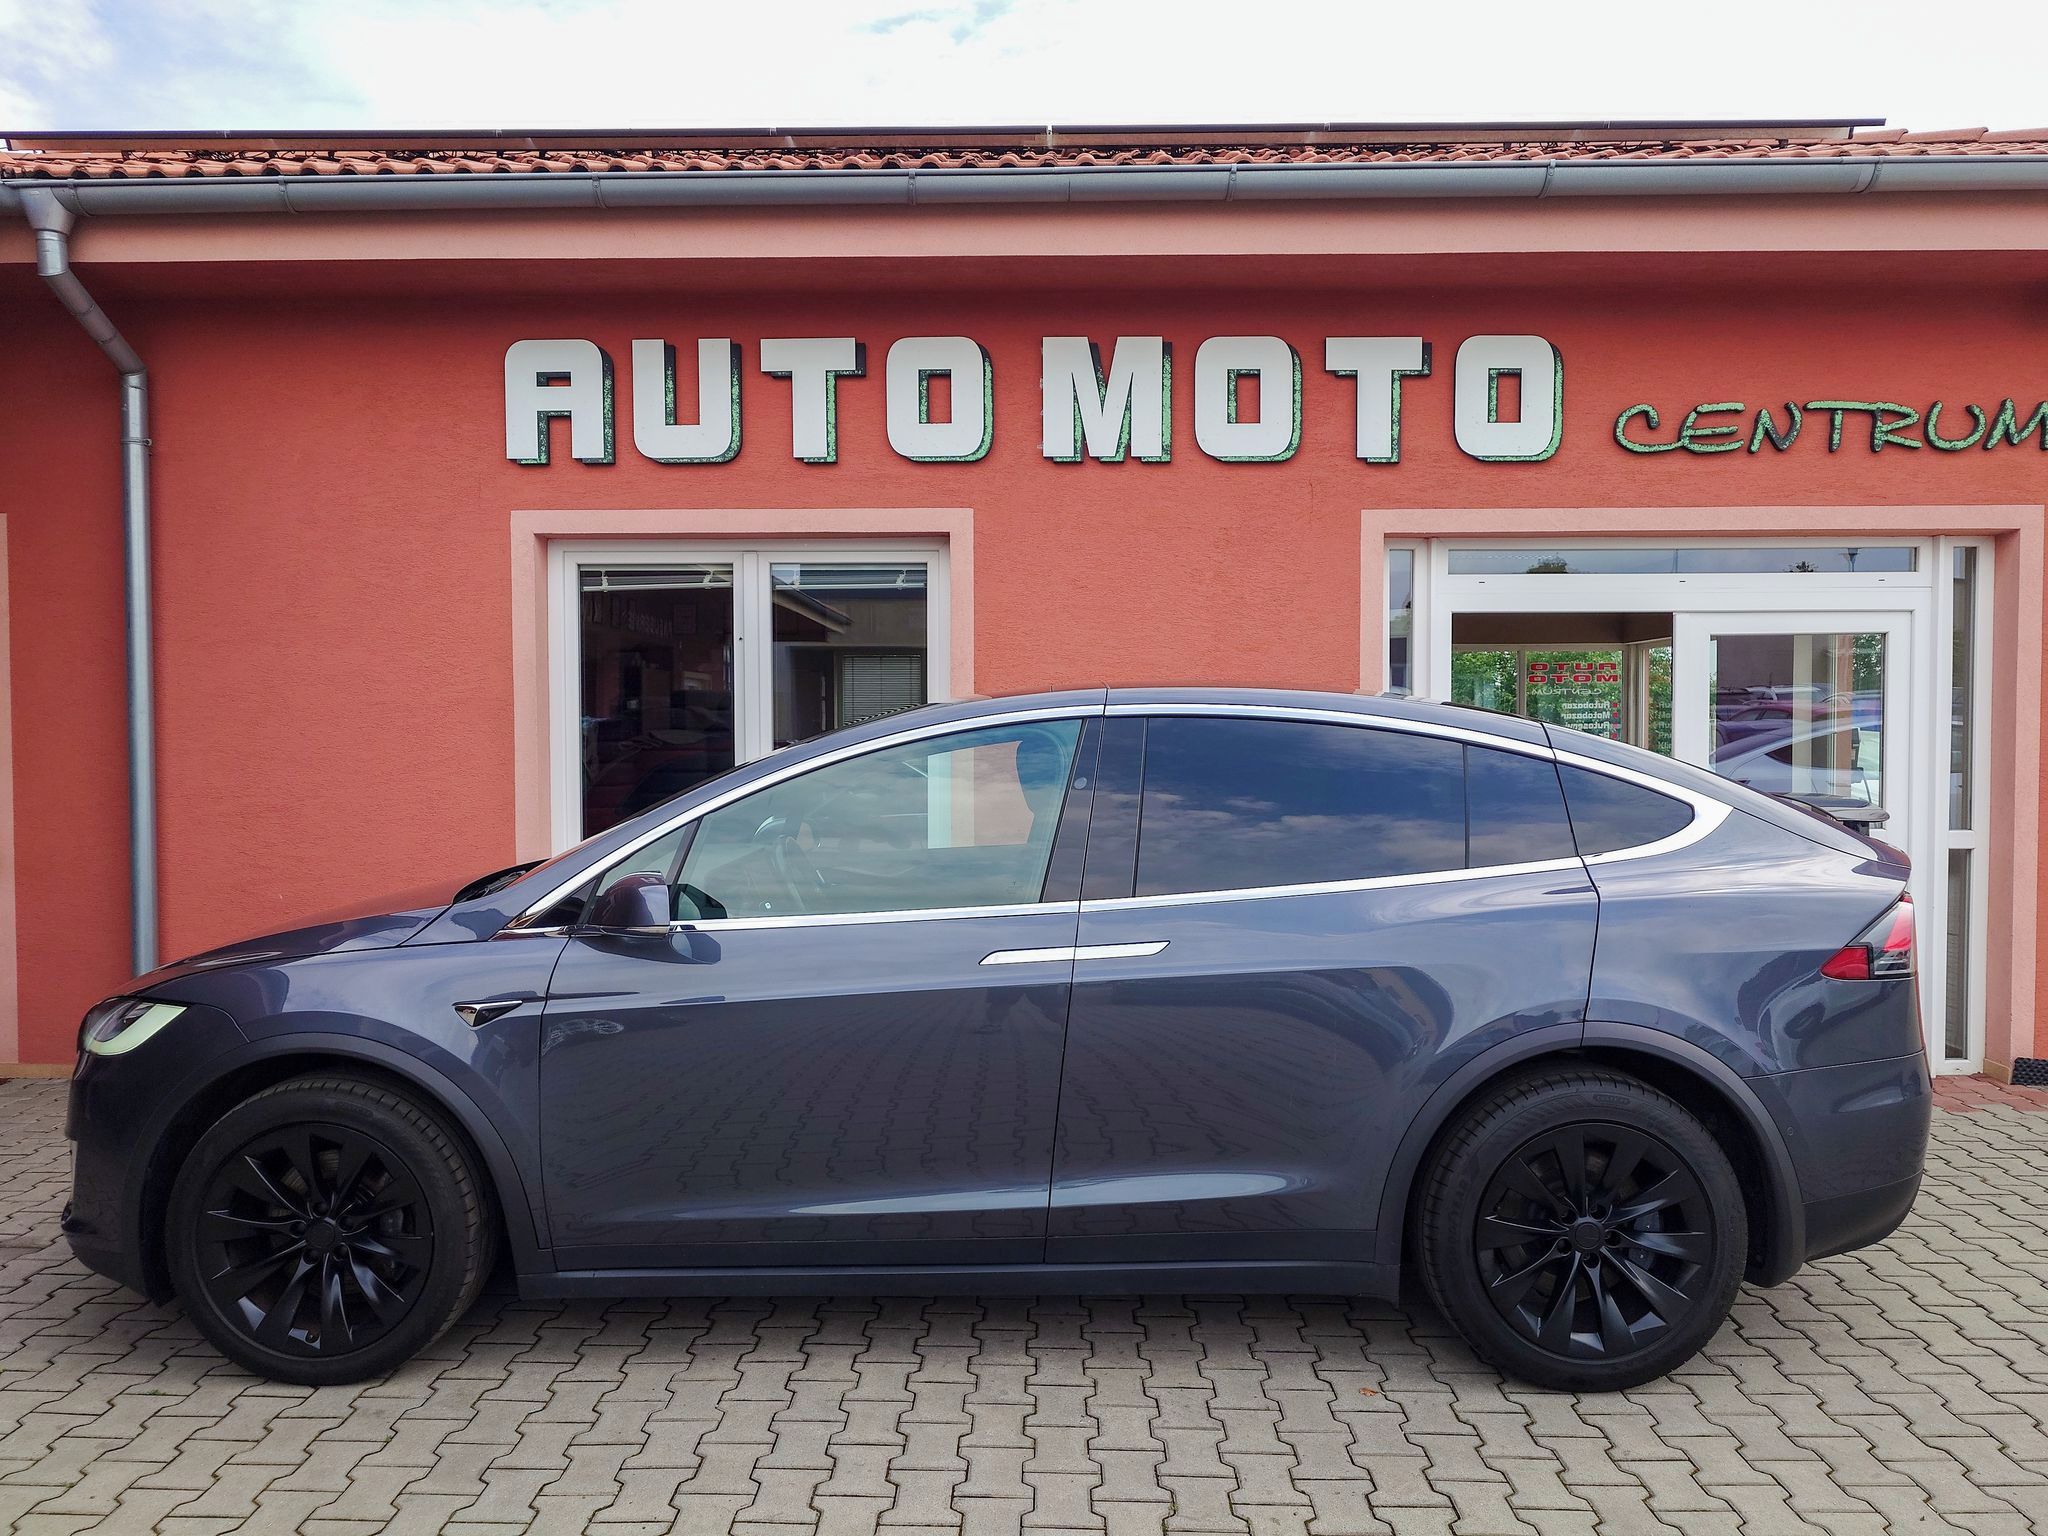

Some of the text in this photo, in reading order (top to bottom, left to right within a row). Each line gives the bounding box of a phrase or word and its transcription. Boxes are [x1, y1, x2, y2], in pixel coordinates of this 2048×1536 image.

[505, 334, 2048, 465] AUTO MOTO CENTRUM
